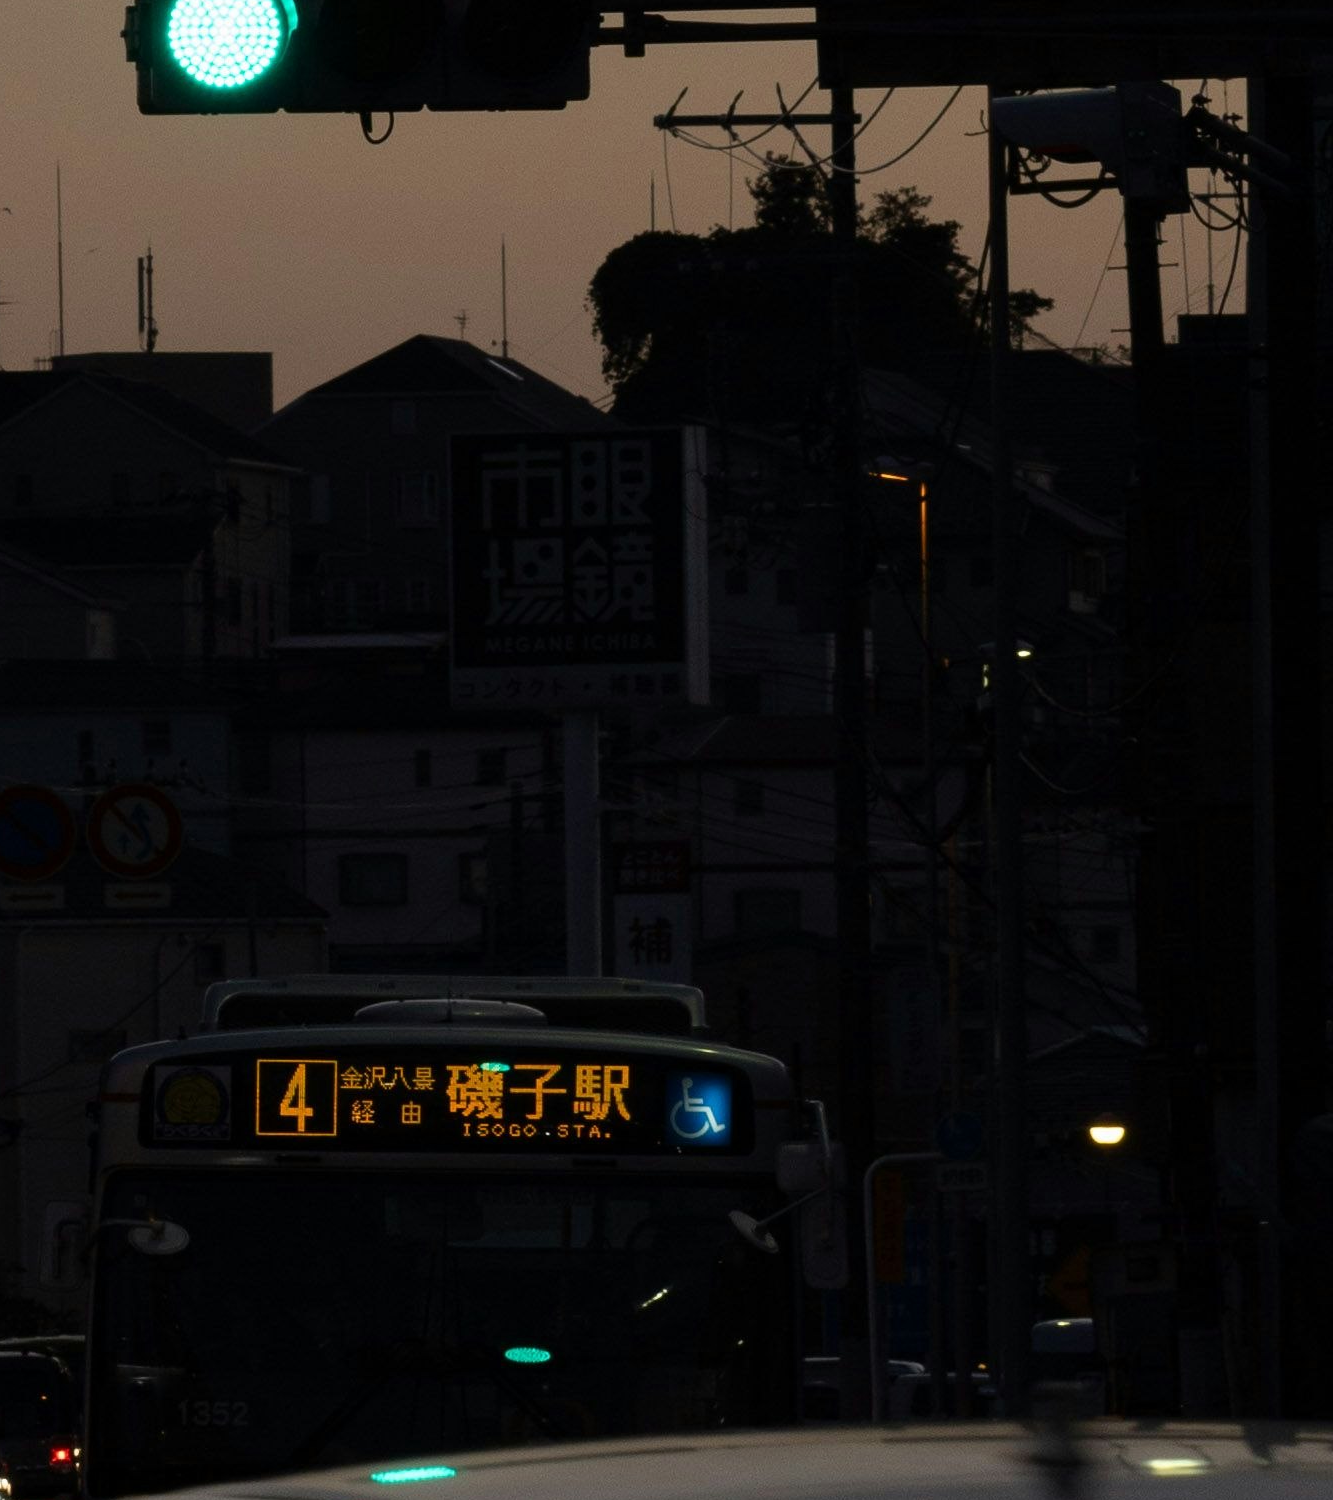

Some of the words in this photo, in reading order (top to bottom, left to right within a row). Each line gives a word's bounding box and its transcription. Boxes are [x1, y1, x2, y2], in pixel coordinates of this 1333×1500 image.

[484, 633, 575, 654] MEGANE
[583, 631, 657, 652] ICHIBA
[340, 1065, 436, 1091] 金沢八景
[278, 1063, 315, 1133] 4
[445, 1064, 631, 1122] 磯子駅
[351, 1099, 422, 1125] 経由
[462, 1122, 538, 1139] ISOGO
[556, 1122, 612, 1139] STA.
[178, 1398, 249, 1427] 1352
